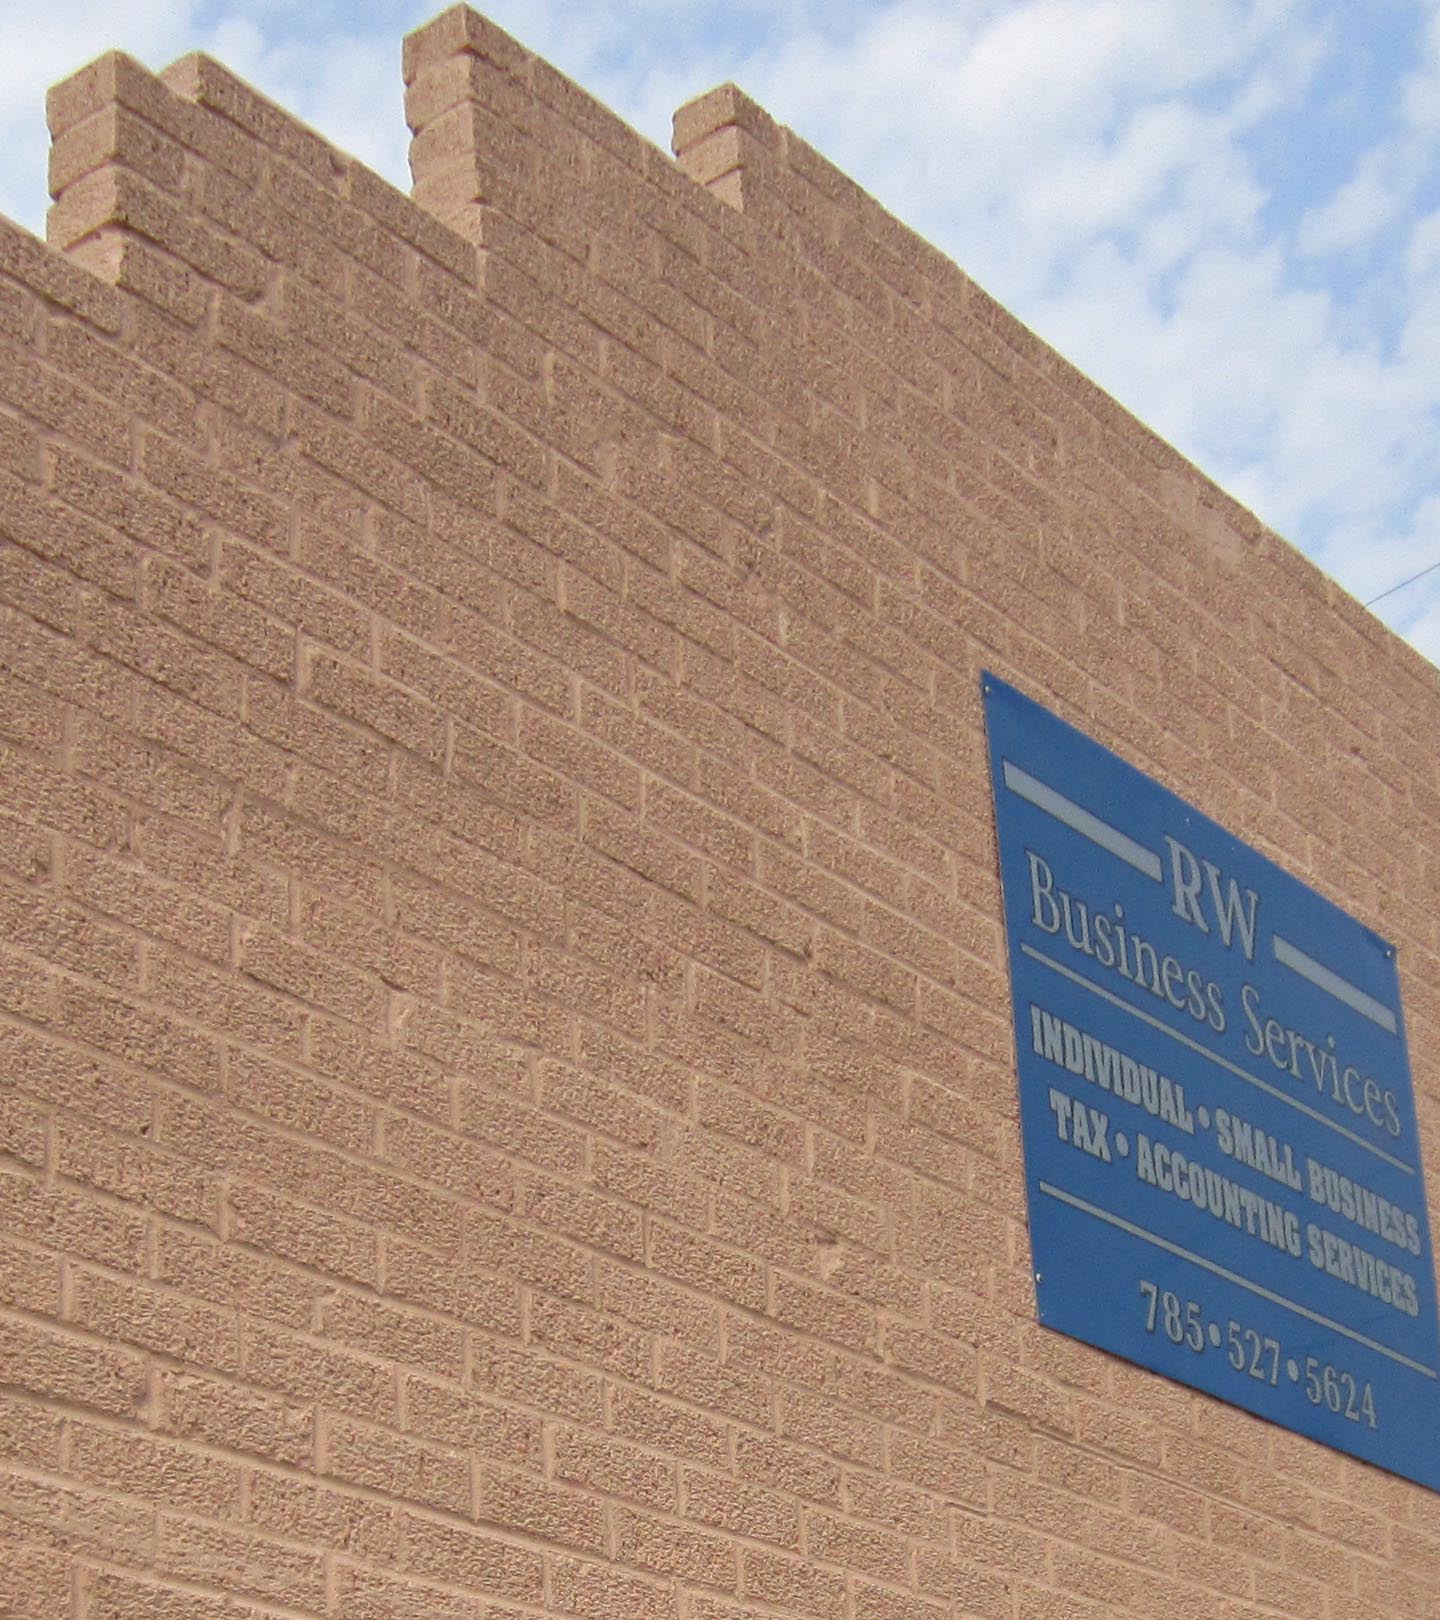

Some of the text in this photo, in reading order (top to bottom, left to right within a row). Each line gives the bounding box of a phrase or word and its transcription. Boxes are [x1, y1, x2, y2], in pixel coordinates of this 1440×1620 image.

[1025, 848, 1402, 1138] Business Services
[1164, 834, 1259, 961] RW
[1030, 1003, 1422, 1257] INDIVIDUAL SMALL BUSINESS
[1049, 1087, 1419, 1318] TAX ACCOUNTING SERVICES
